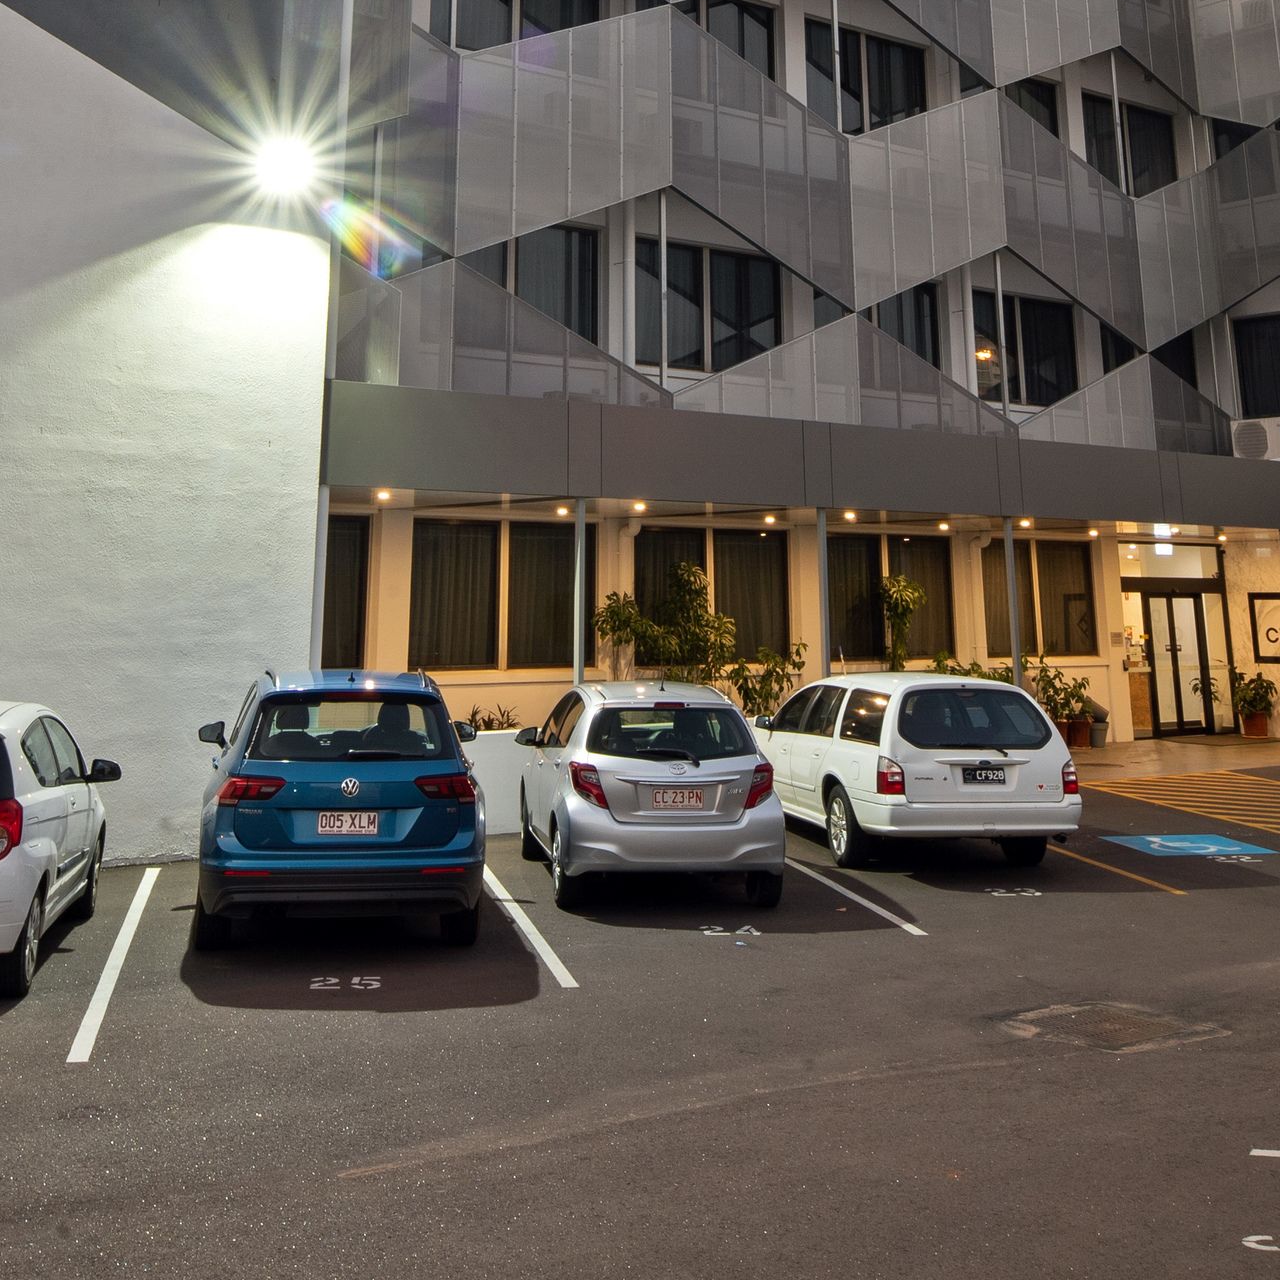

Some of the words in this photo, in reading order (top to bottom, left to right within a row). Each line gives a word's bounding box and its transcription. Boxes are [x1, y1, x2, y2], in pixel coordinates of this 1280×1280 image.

[984, 888, 1042, 896] 23
[699, 925, 762, 935] 24
[309, 977, 381, 989] 25
